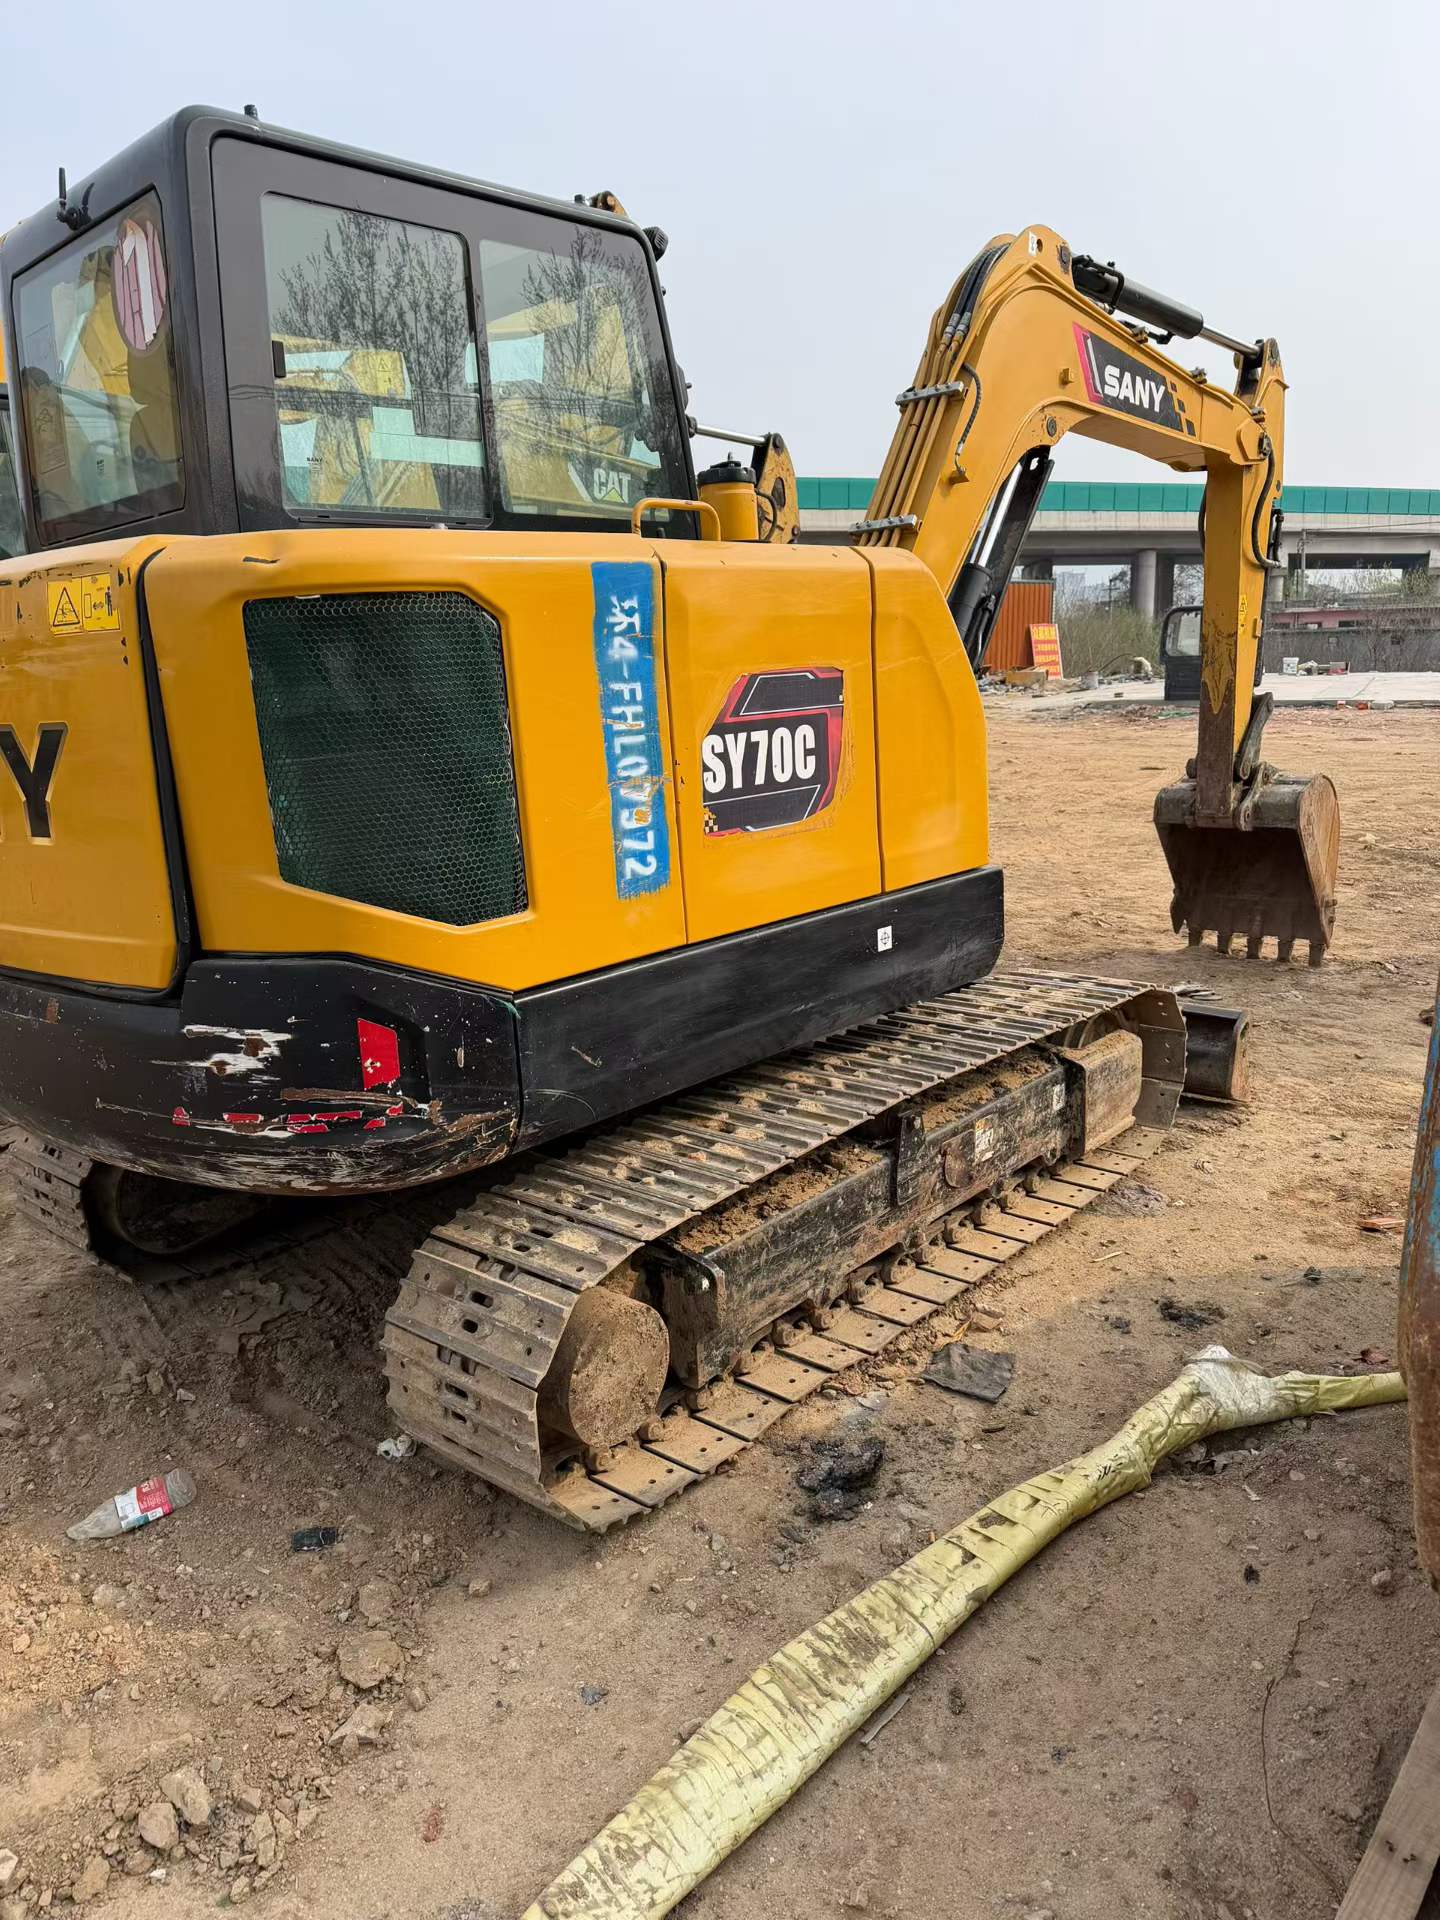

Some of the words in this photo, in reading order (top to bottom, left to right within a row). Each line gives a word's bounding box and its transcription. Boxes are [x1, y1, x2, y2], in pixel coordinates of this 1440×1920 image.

[1104, 364, 1165, 413] SANY
[593, 467, 632, 504] CAT
[0, 722, 68, 844] Y
[701, 724, 816, 794] SY70C
